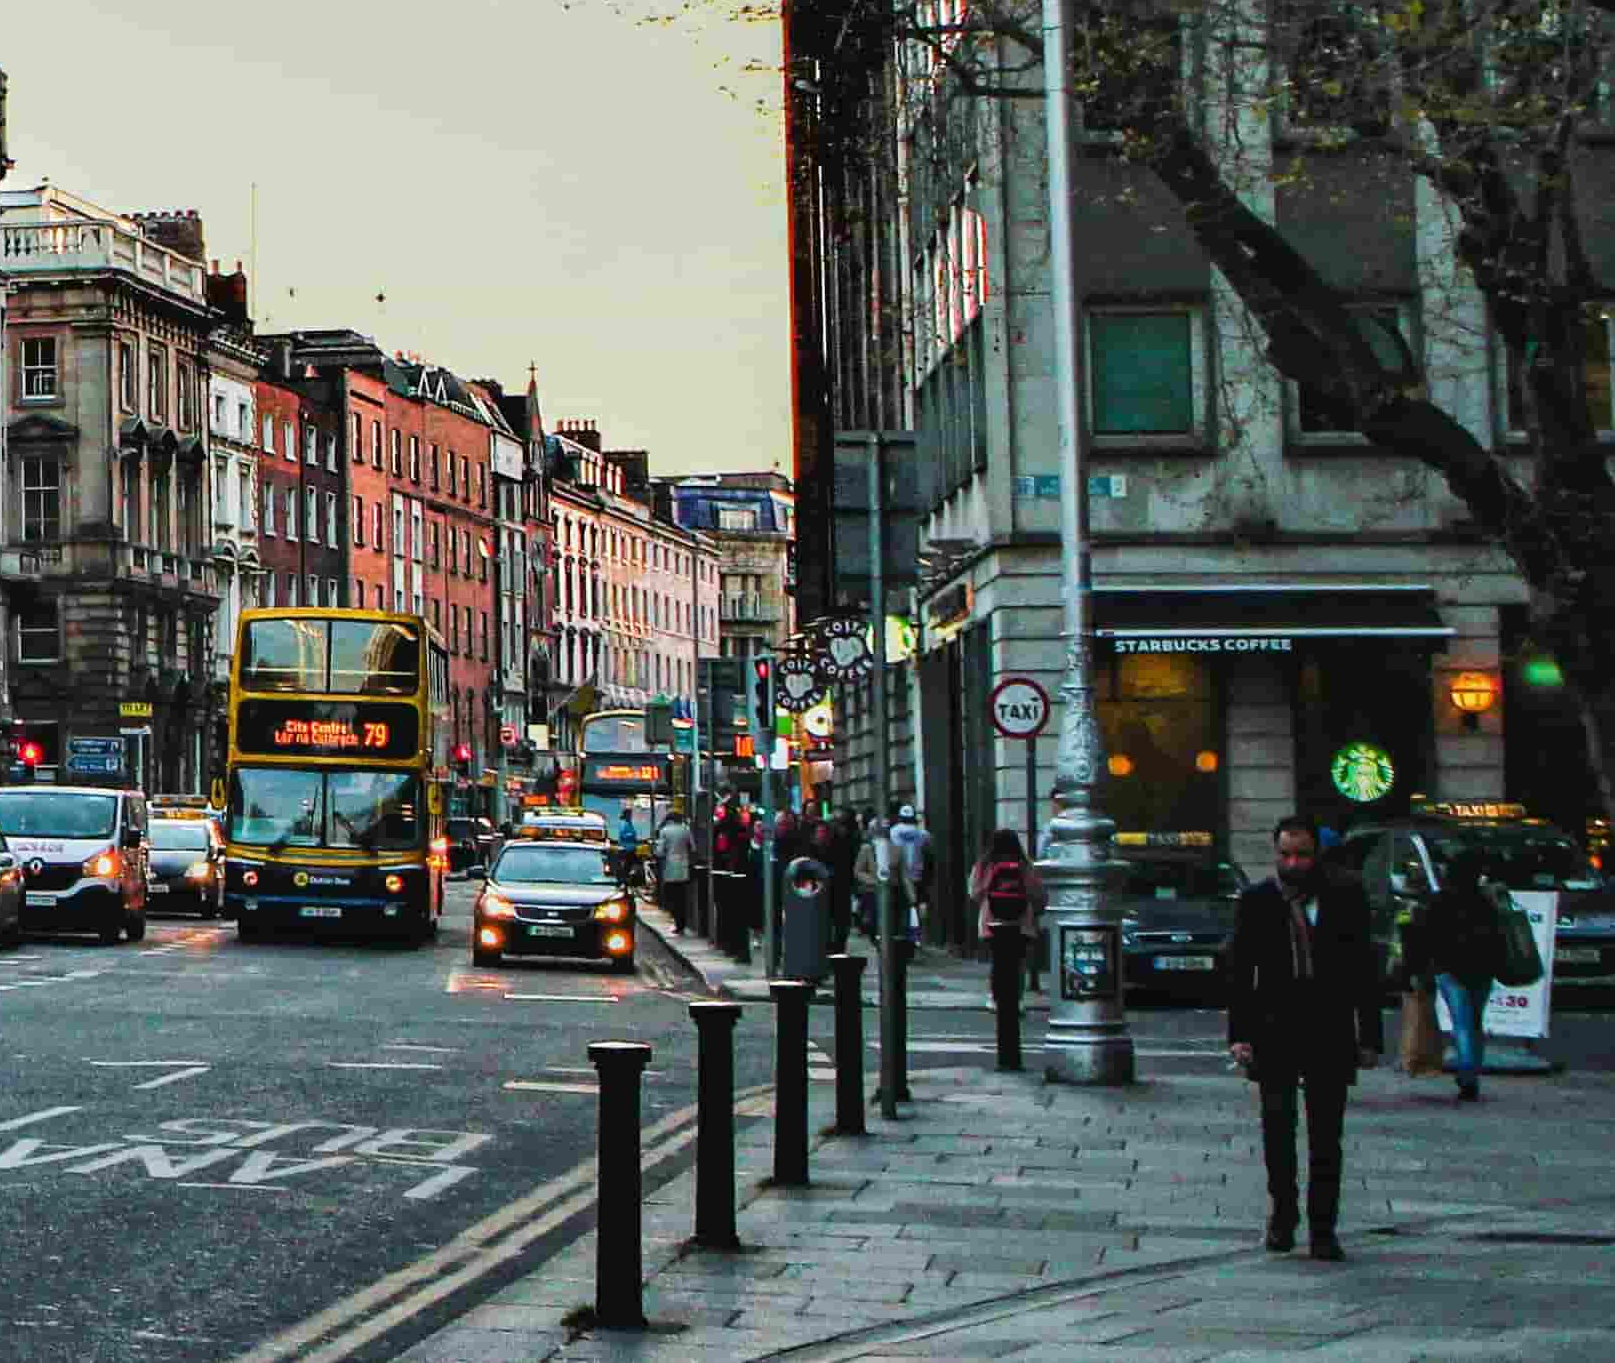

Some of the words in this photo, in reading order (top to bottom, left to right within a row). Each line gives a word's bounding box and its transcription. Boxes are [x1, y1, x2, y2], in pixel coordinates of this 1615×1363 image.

[824, 622, 866, 637] COSTA
[1115, 640, 1221, 653] STARBUCKS
[1224, 638, 1292, 651] COFFEE
[364, 723, 387, 747] 79
